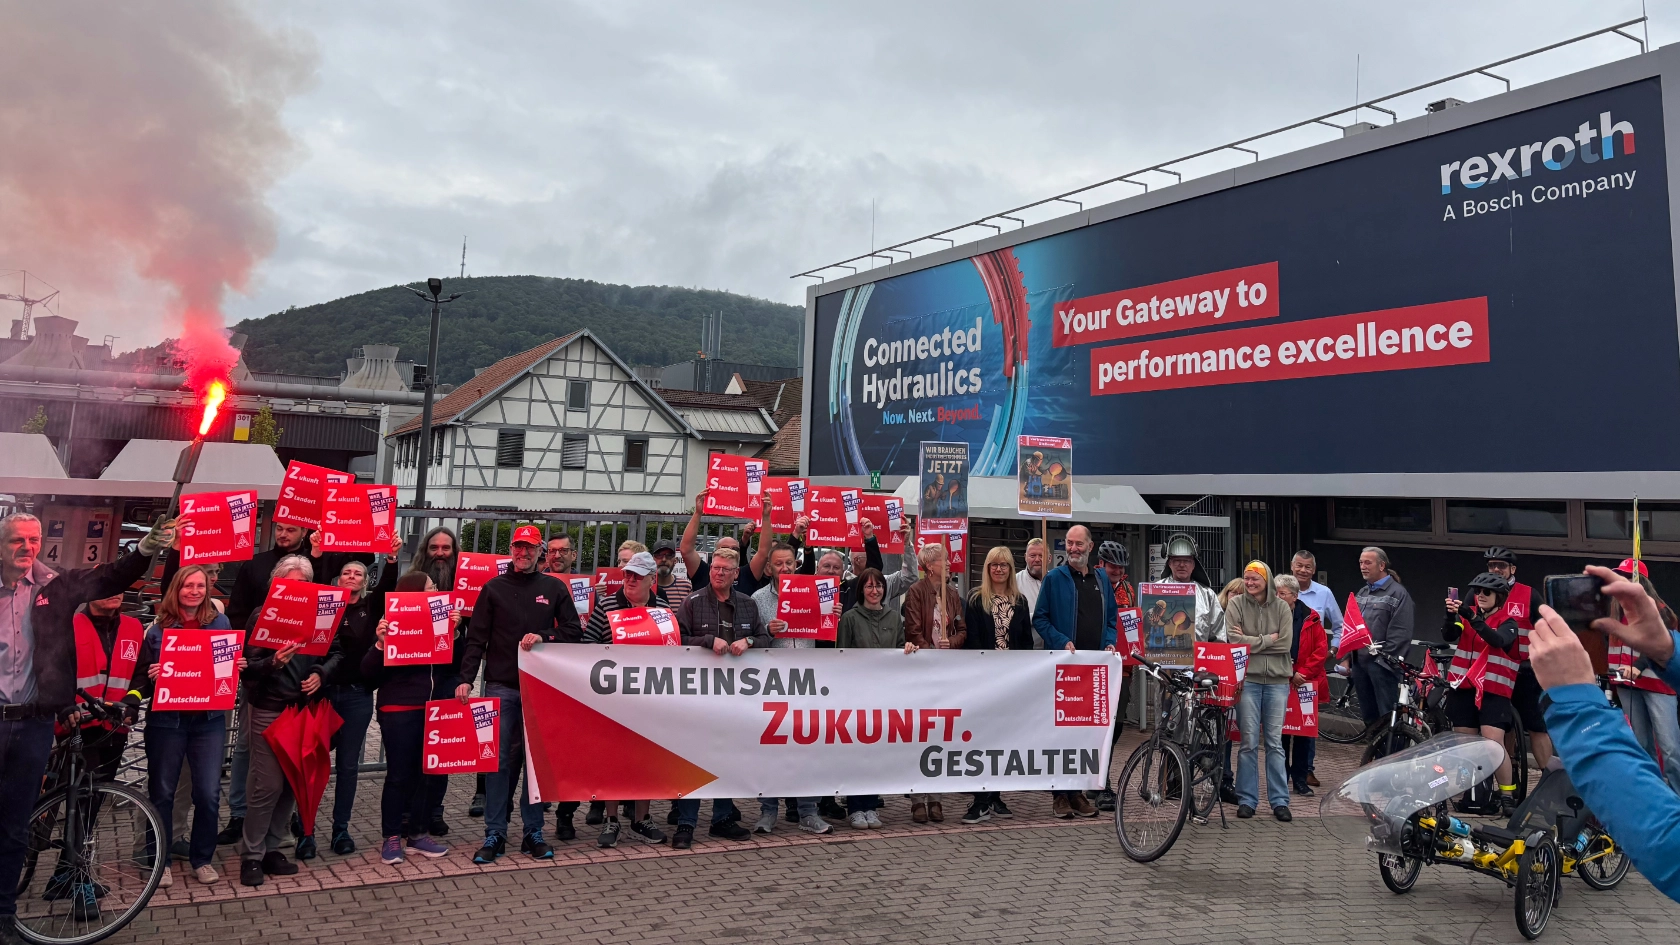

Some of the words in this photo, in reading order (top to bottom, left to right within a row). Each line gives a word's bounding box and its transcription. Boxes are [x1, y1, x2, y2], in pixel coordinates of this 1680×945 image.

[1441, 111, 1635, 195] rexroth
[1443, 204, 1456, 221] A
[1463, 190, 1523, 217] Bosch
[1531, 170, 1637, 203] Company
[1059, 307, 1111, 335] Your
[1116, 288, 1231, 326] Gateway
[1236, 279, 1267, 307] to
[863, 317, 982, 367] Connected
[1098, 342, 1270, 389] performance
[1278, 319, 1472, 364] excellence
[863, 361, 982, 409] Hydraulics
[883, 410, 906, 425] Now.
[908, 408, 935, 423] Next.
[937, 403, 982, 425] Beyond.
[712, 458, 739, 472] Zukunft
[928, 460, 963, 474] JETZT
[288, 466, 319, 484] Zukunft
[710, 477, 739, 492] Standort
[283, 487, 316, 504] Standort
[327, 489, 360, 502] Zukunft
[811, 491, 836, 503] Zukunft
[184, 500, 220, 514] Zukunft
[707, 497, 745, 512] Deutschland
[278, 505, 321, 525] Deutschland
[325, 511, 362, 524] Standort
[811, 510, 838, 522] Standort
[184, 522, 222, 536] Standort
[810, 529, 845, 542] Deutschland
[324, 532, 371, 546] Deutschland
[47, 545, 58, 561] 4
[87, 545, 97, 561] 3
[184, 545, 231, 560] Deutschland
[460, 557, 489, 571] Zukunft
[1057, 555, 1064, 566] 2
[272, 584, 308, 603] Zukunft
[782, 580, 810, 593] Zukunft
[389, 598, 421, 612] Zukunft
[780, 600, 811, 613] Standort
[263, 607, 303, 626] Standort
[611, 614, 642, 625] Zukunft
[388, 621, 422, 635] Standort
[616, 627, 649, 642] Standort
[165, 636, 202, 651] Zukunft
[225, 645, 240, 653] JETZT
[388, 645, 431, 659] Deutschland
[1197, 647, 1226, 660] Zukunft
[161, 661, 201, 677] Standort
[1056, 670, 1081, 682] Zukunft
[590, 658, 830, 697] GEMEINSAM.
[157, 688, 210, 704] Deutschland
[1056, 689, 1083, 702] Standort
[429, 707, 463, 721] Zukunft
[1056, 710, 1092, 722] Deutschland
[760, 701, 972, 745] ZUKUNFT.
[428, 730, 465, 745] Standort
[427, 754, 476, 769] Deutschland
[919, 745, 1100, 777] GESTALTEN
